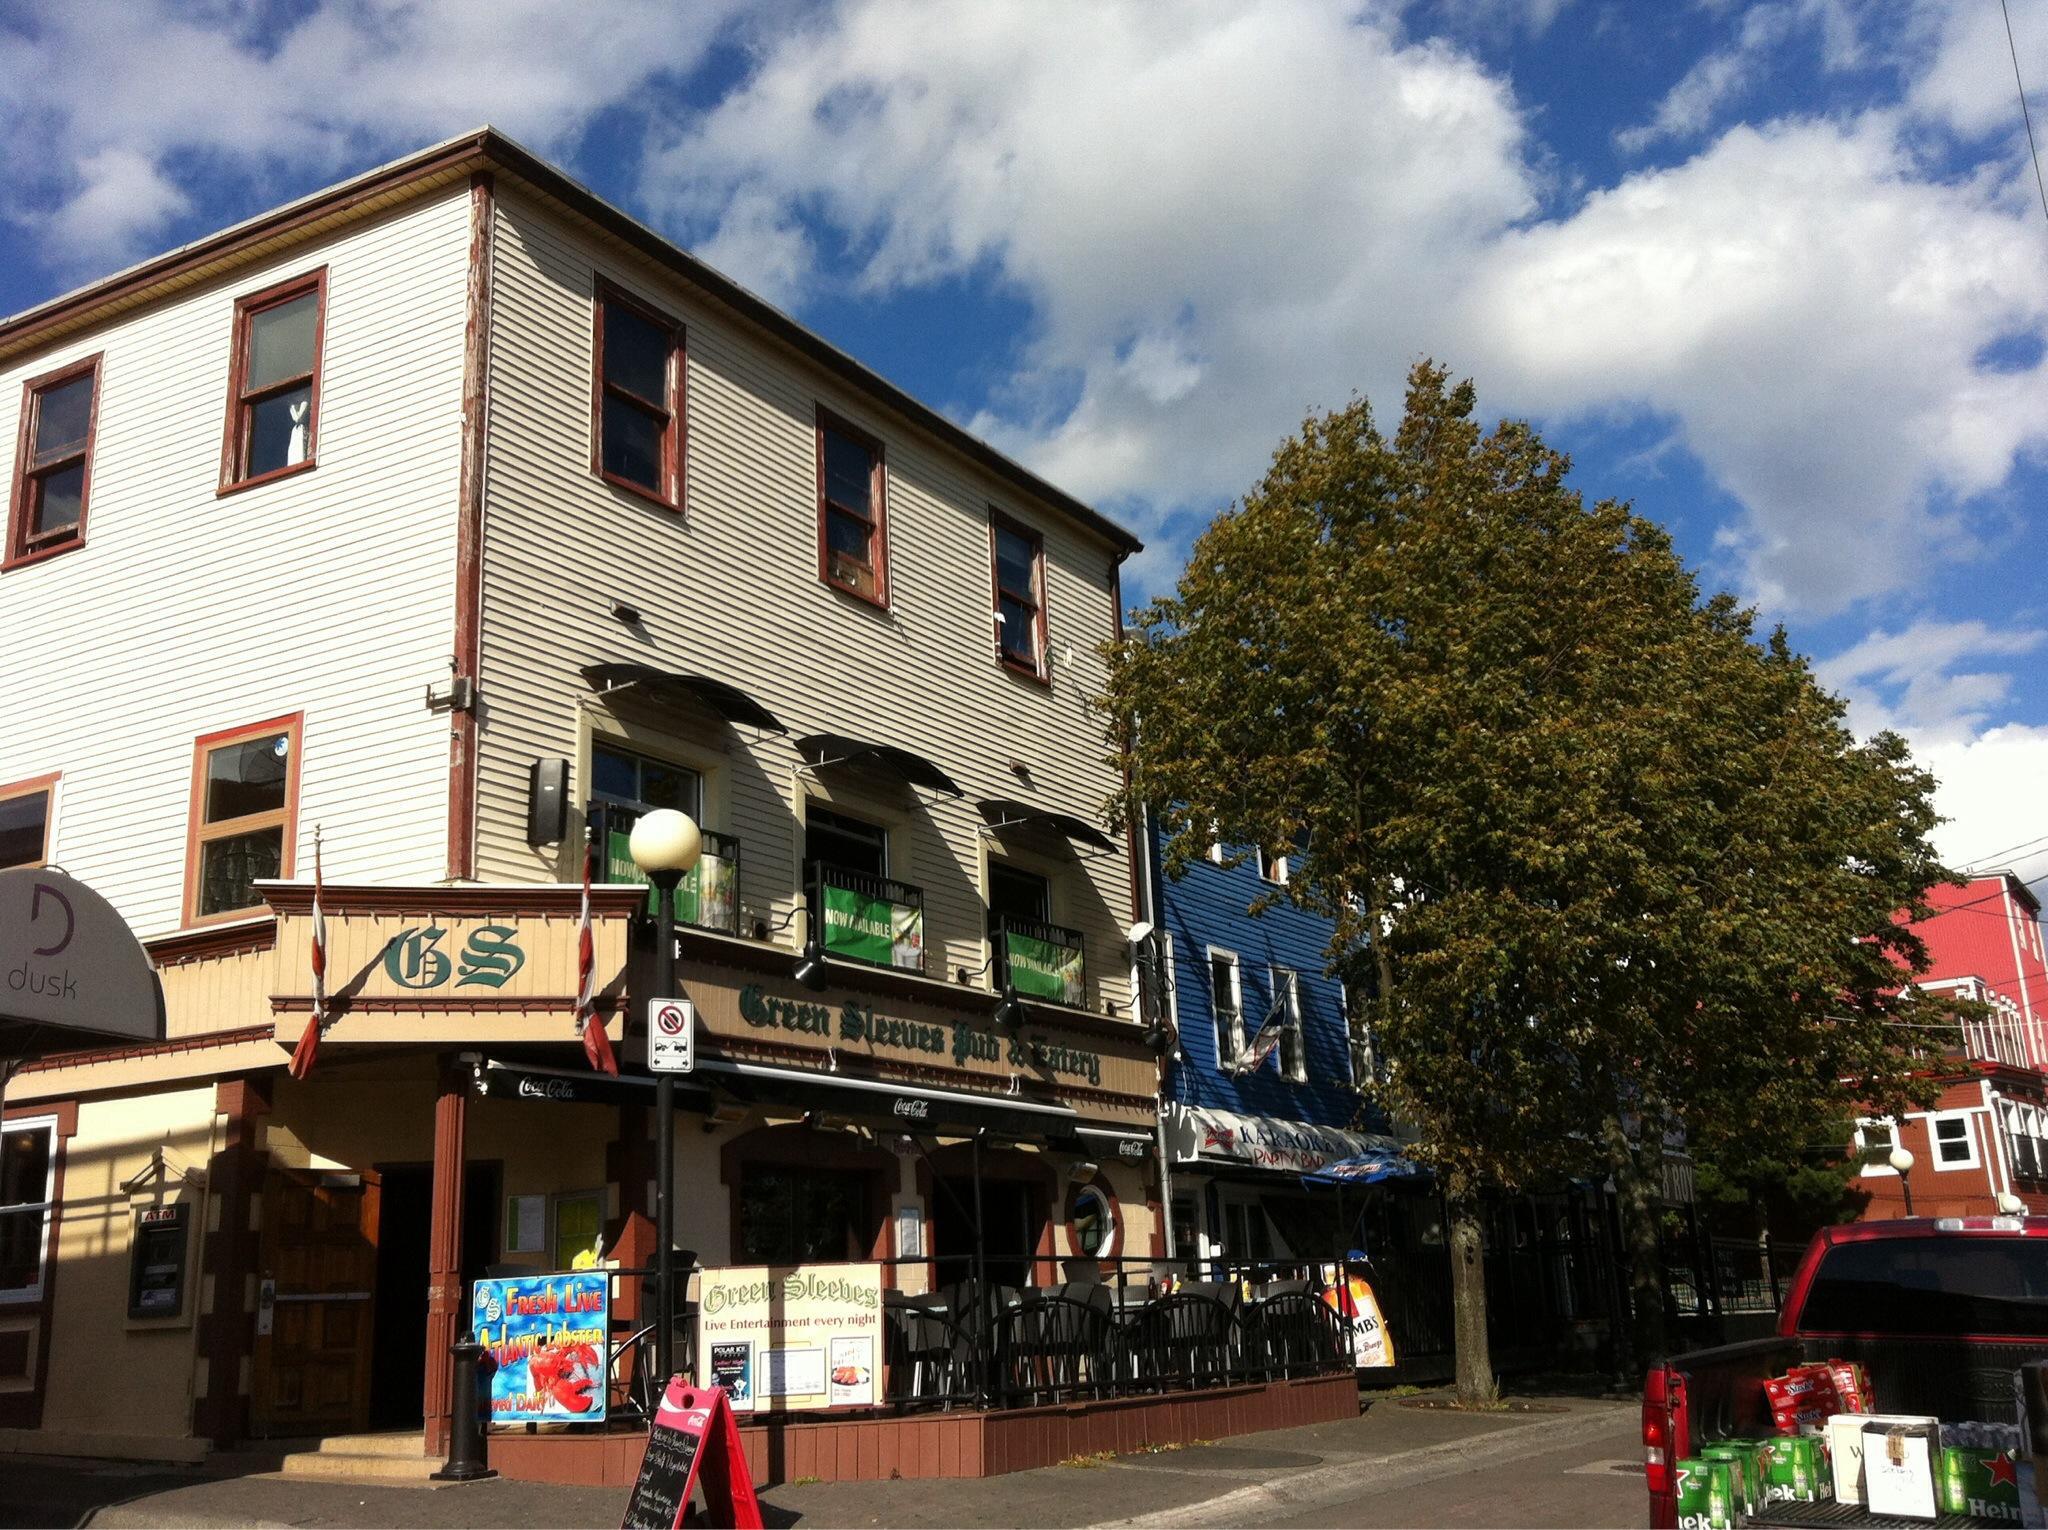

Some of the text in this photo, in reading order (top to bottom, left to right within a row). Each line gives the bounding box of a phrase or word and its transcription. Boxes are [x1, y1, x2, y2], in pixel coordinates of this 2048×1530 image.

[826, 909, 890, 938] NOW AAILABLE
[384, 925, 525, 989] GS
[1009, 953, 1026, 968] NOW
[8, 962, 77, 999] dusk
[738, 983, 1101, 1086] Green Sleeves Pub & Eatery
[1241, 1126, 1334, 1154] KARAOKE
[1254, 1147, 1296, 1165] PARTY
[145, 1209, 175, 1221] ATM
[704, 1273, 878, 1315] Green Sleeves
[705, 1313, 876, 1331] Live Entertainment every night
[1353, 1315, 1379, 1337] MB'S
[1968, 1499, 2019, 1519] Hein
